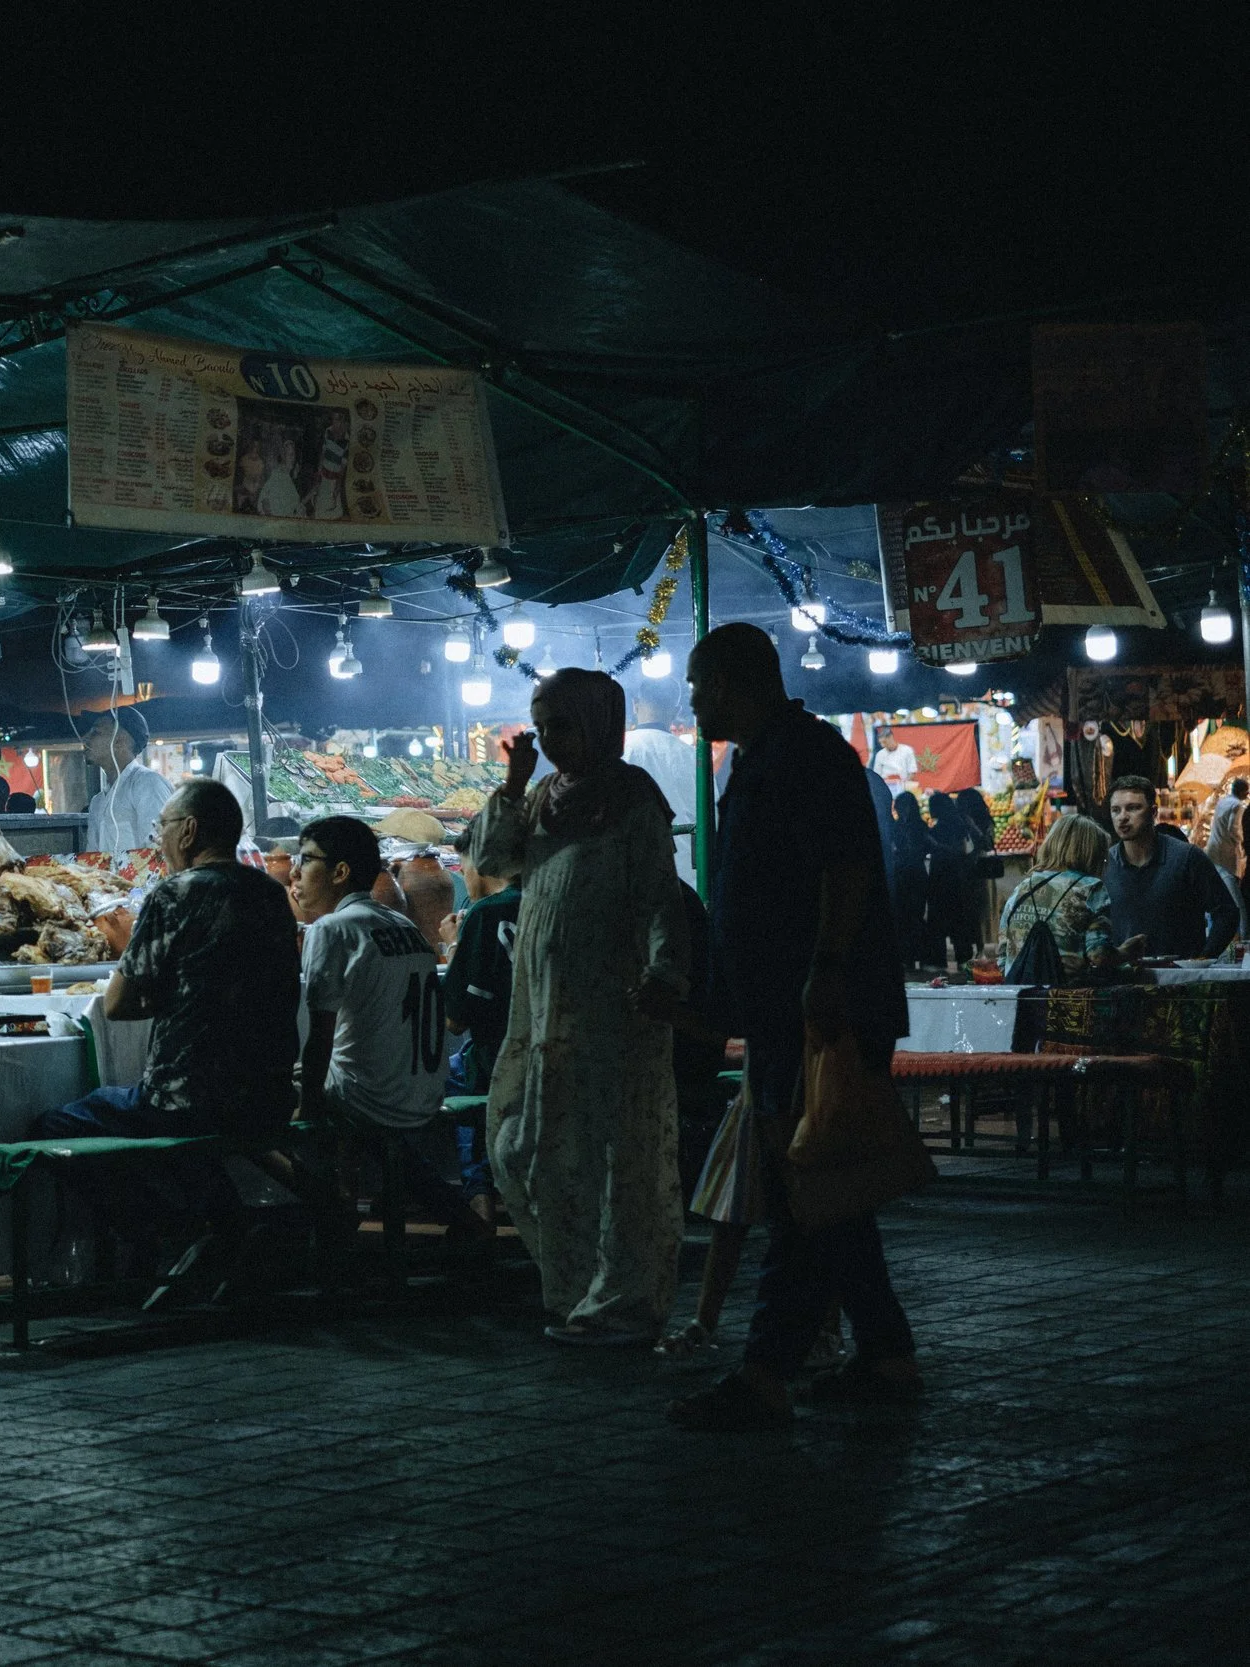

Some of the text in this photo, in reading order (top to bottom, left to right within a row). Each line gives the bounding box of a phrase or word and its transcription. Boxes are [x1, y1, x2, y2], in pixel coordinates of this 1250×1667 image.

[149, 348, 187, 368] Ahmed
[249, 362, 317, 399] N° 10
[961, 511, 1031, 543] مرحبا
[913, 585, 937, 603] N°
[936, 545, 1036, 629] 41
[401, 970, 446, 1076] 10
